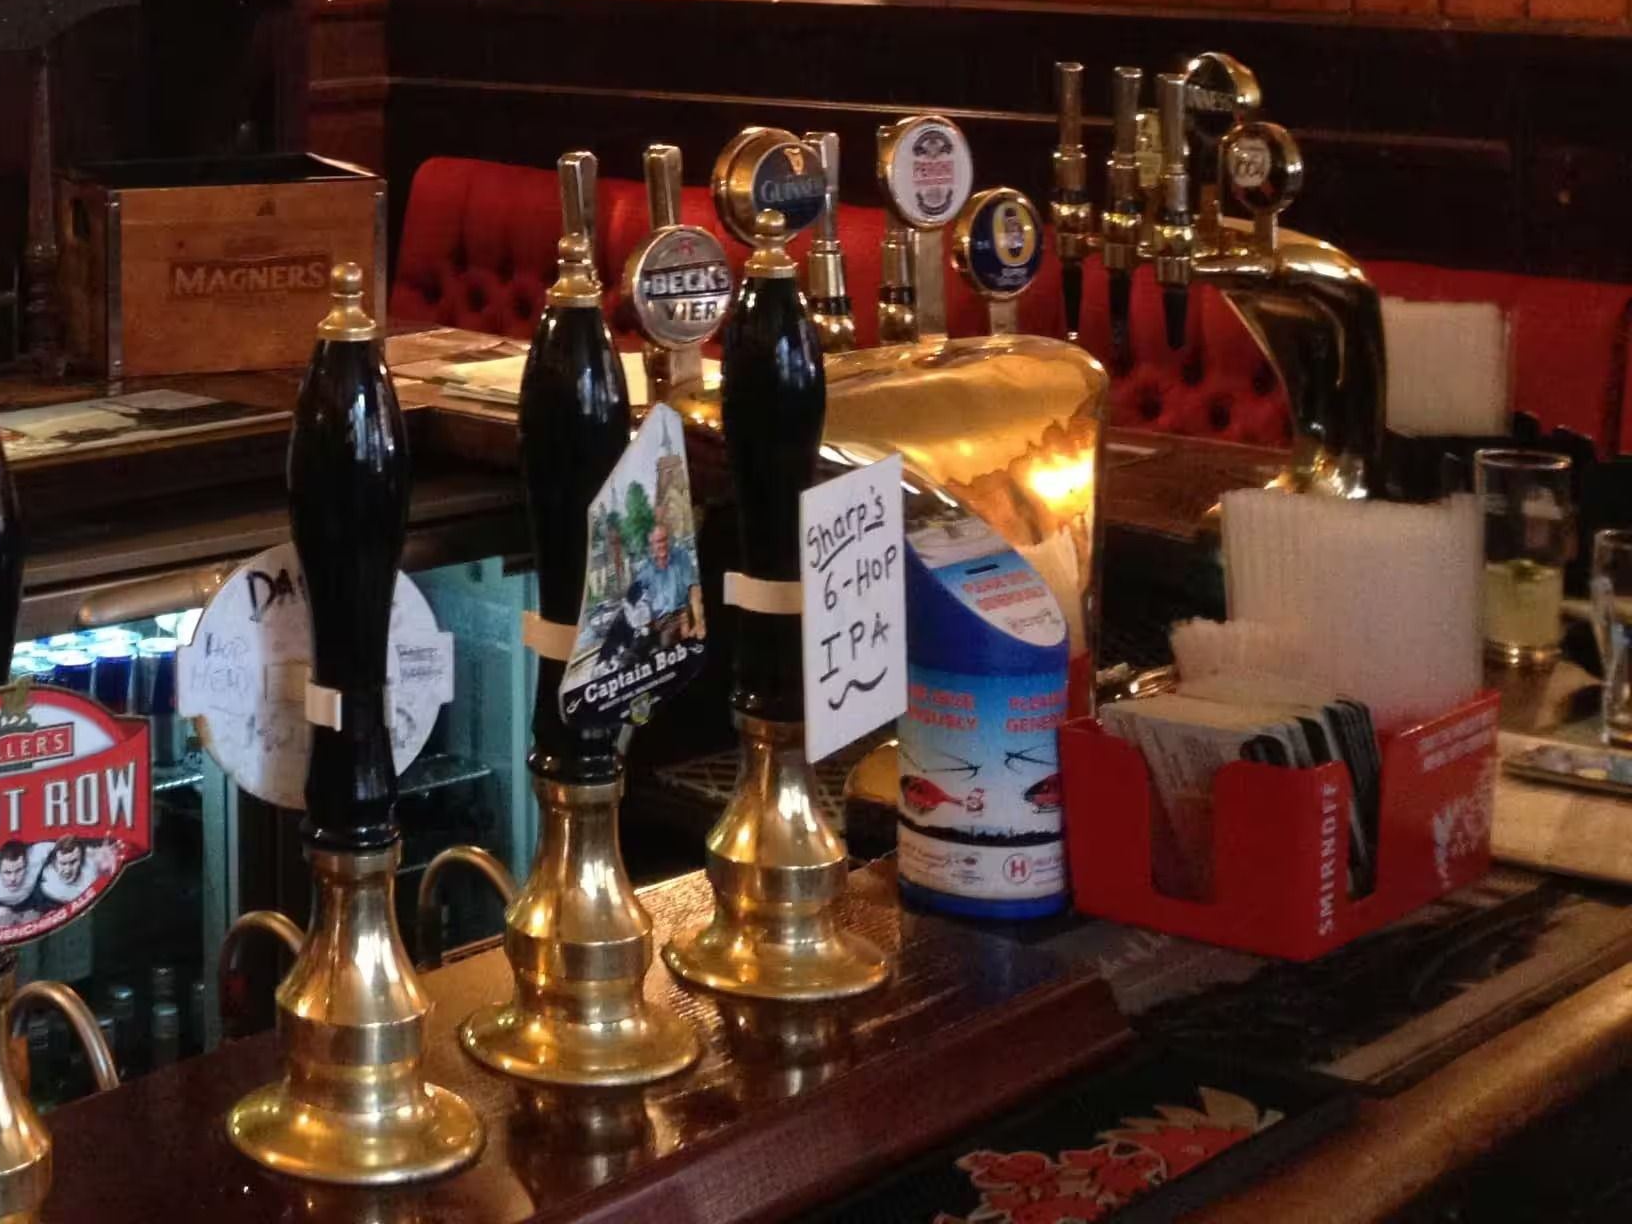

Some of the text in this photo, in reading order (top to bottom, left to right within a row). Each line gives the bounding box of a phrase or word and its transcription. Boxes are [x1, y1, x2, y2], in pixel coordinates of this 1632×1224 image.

[173, 262, 327, 296] MAGNERS
[667, 300, 718, 322] VIER
[805, 486, 886, 569] Sharp's
[584, 663, 653, 703] Captain
[654, 643, 688, 671] Bob
[43, 762, 137, 829] ROW
[1318, 782, 1339, 938] SMIRNOFF
